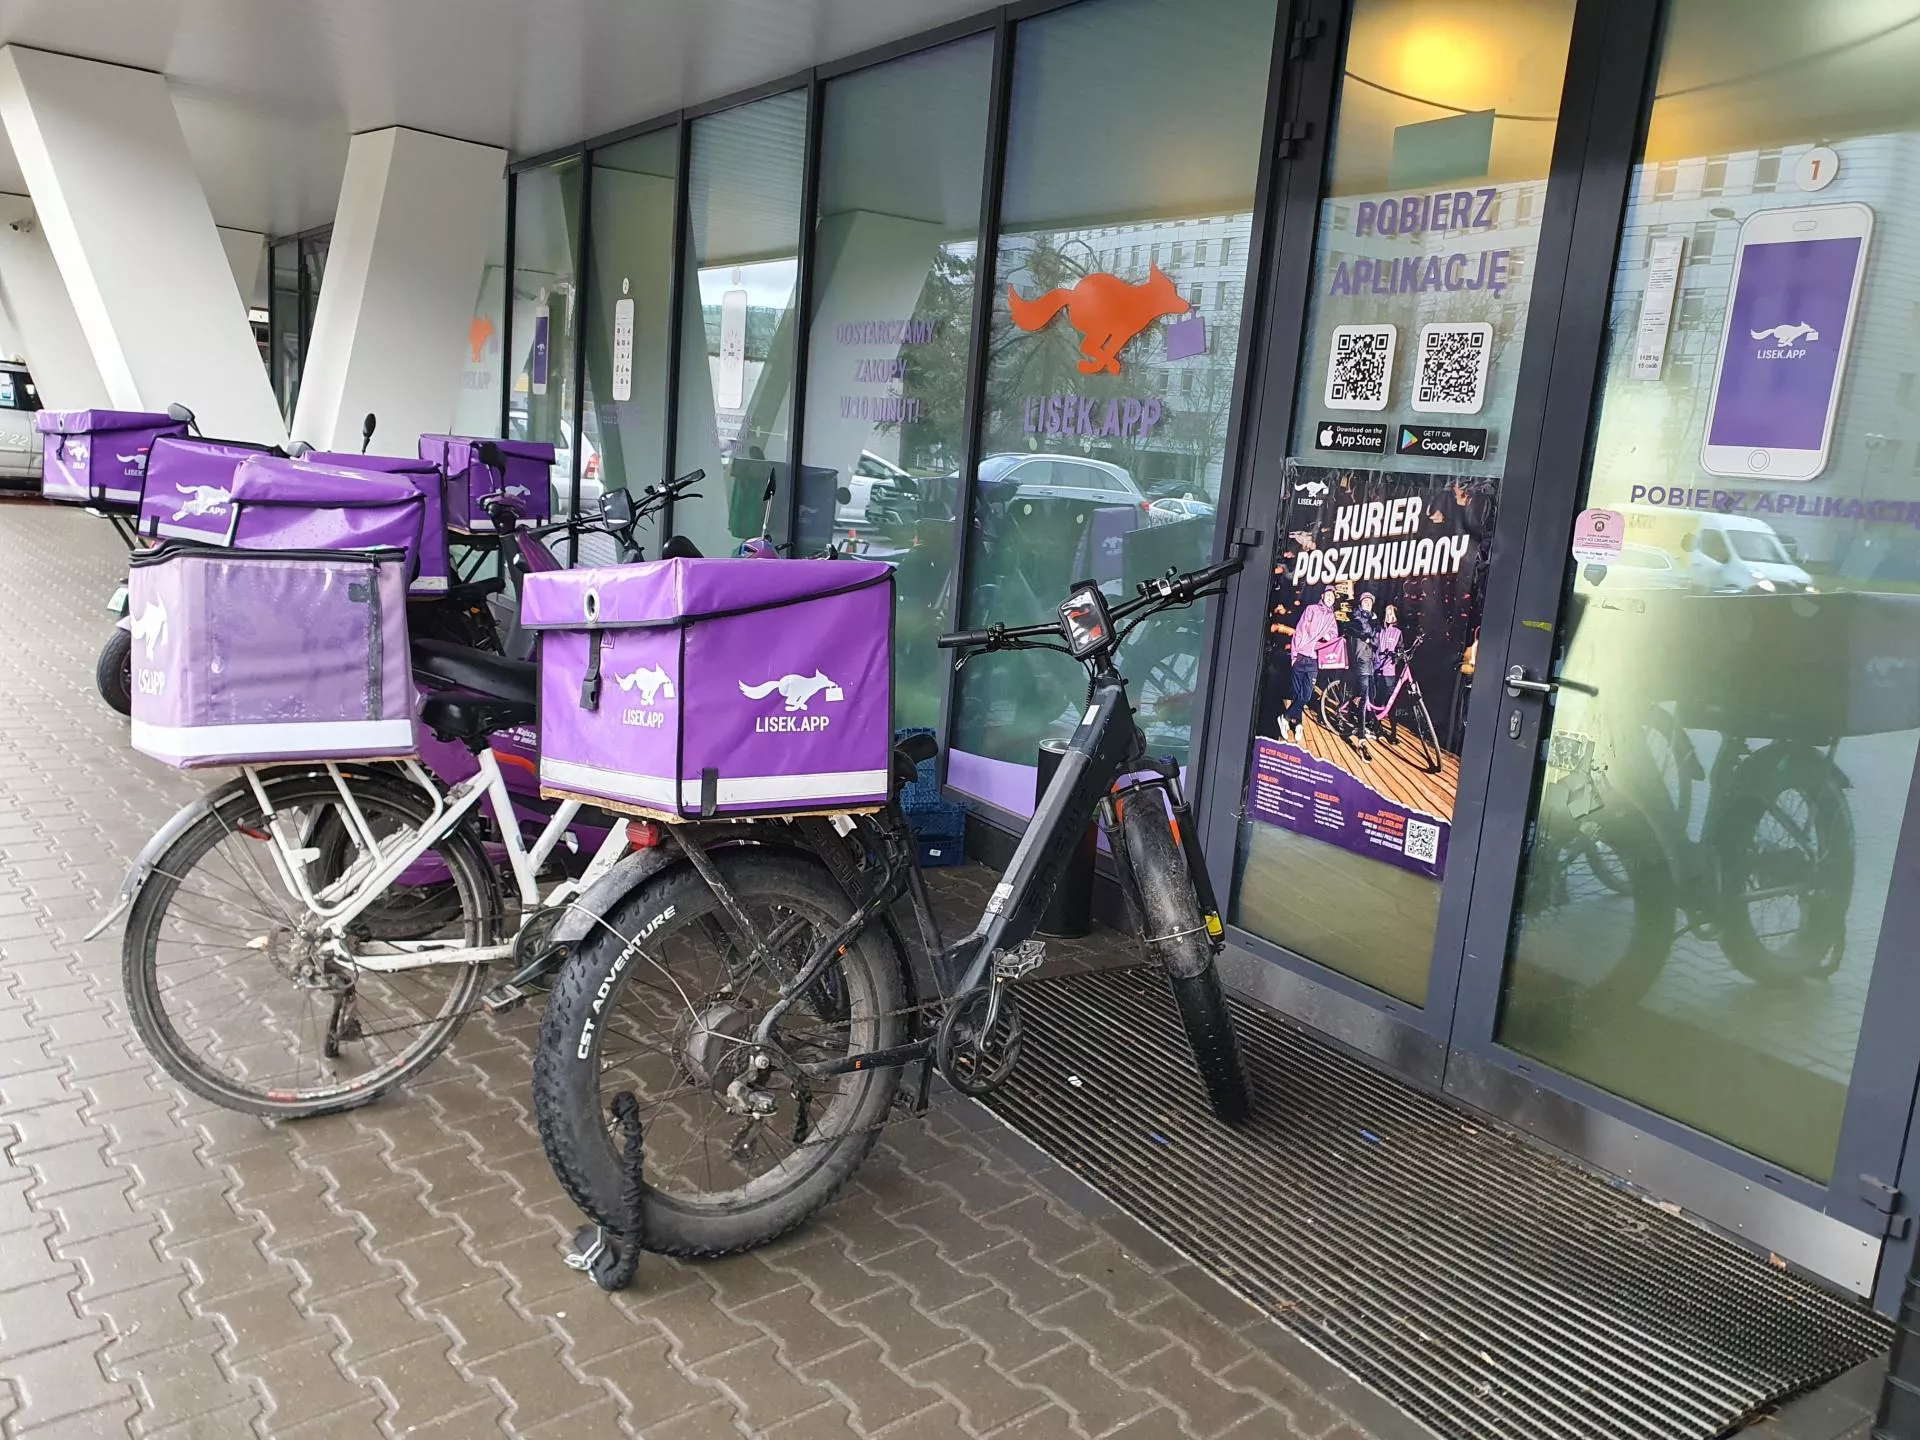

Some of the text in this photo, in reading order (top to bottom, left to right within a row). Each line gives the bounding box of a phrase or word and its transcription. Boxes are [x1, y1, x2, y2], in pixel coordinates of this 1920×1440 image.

[1811, 159, 1821, 181] 1
[1356, 188, 1497, 237] POBIERZ
[1330, 250, 1510, 299] APLIKACJĘ
[1757, 349, 1806, 359] LISEK.APP
[856, 359, 908, 382] ZAKUPY
[871, 397, 920, 423] MINUT!
[1023, 394, 1162, 438] LISEK.APP
[1336, 426, 1364, 434] Download
[1336, 434, 1381, 447] App Store
[1422, 439, 1480, 456] Google Play
[124, 467, 145, 477] LISEK
[1630, 484, 1747, 512] POBIERZ
[1333, 496, 1423, 543] KURIER
[1292, 534, 1470, 587] POSZUKIWANY
[622, 709, 665, 729] LISEK.APP
[755, 716, 830, 733] LISEK.APP
[577, 905, 676, 1060] CST ADVENTURE
